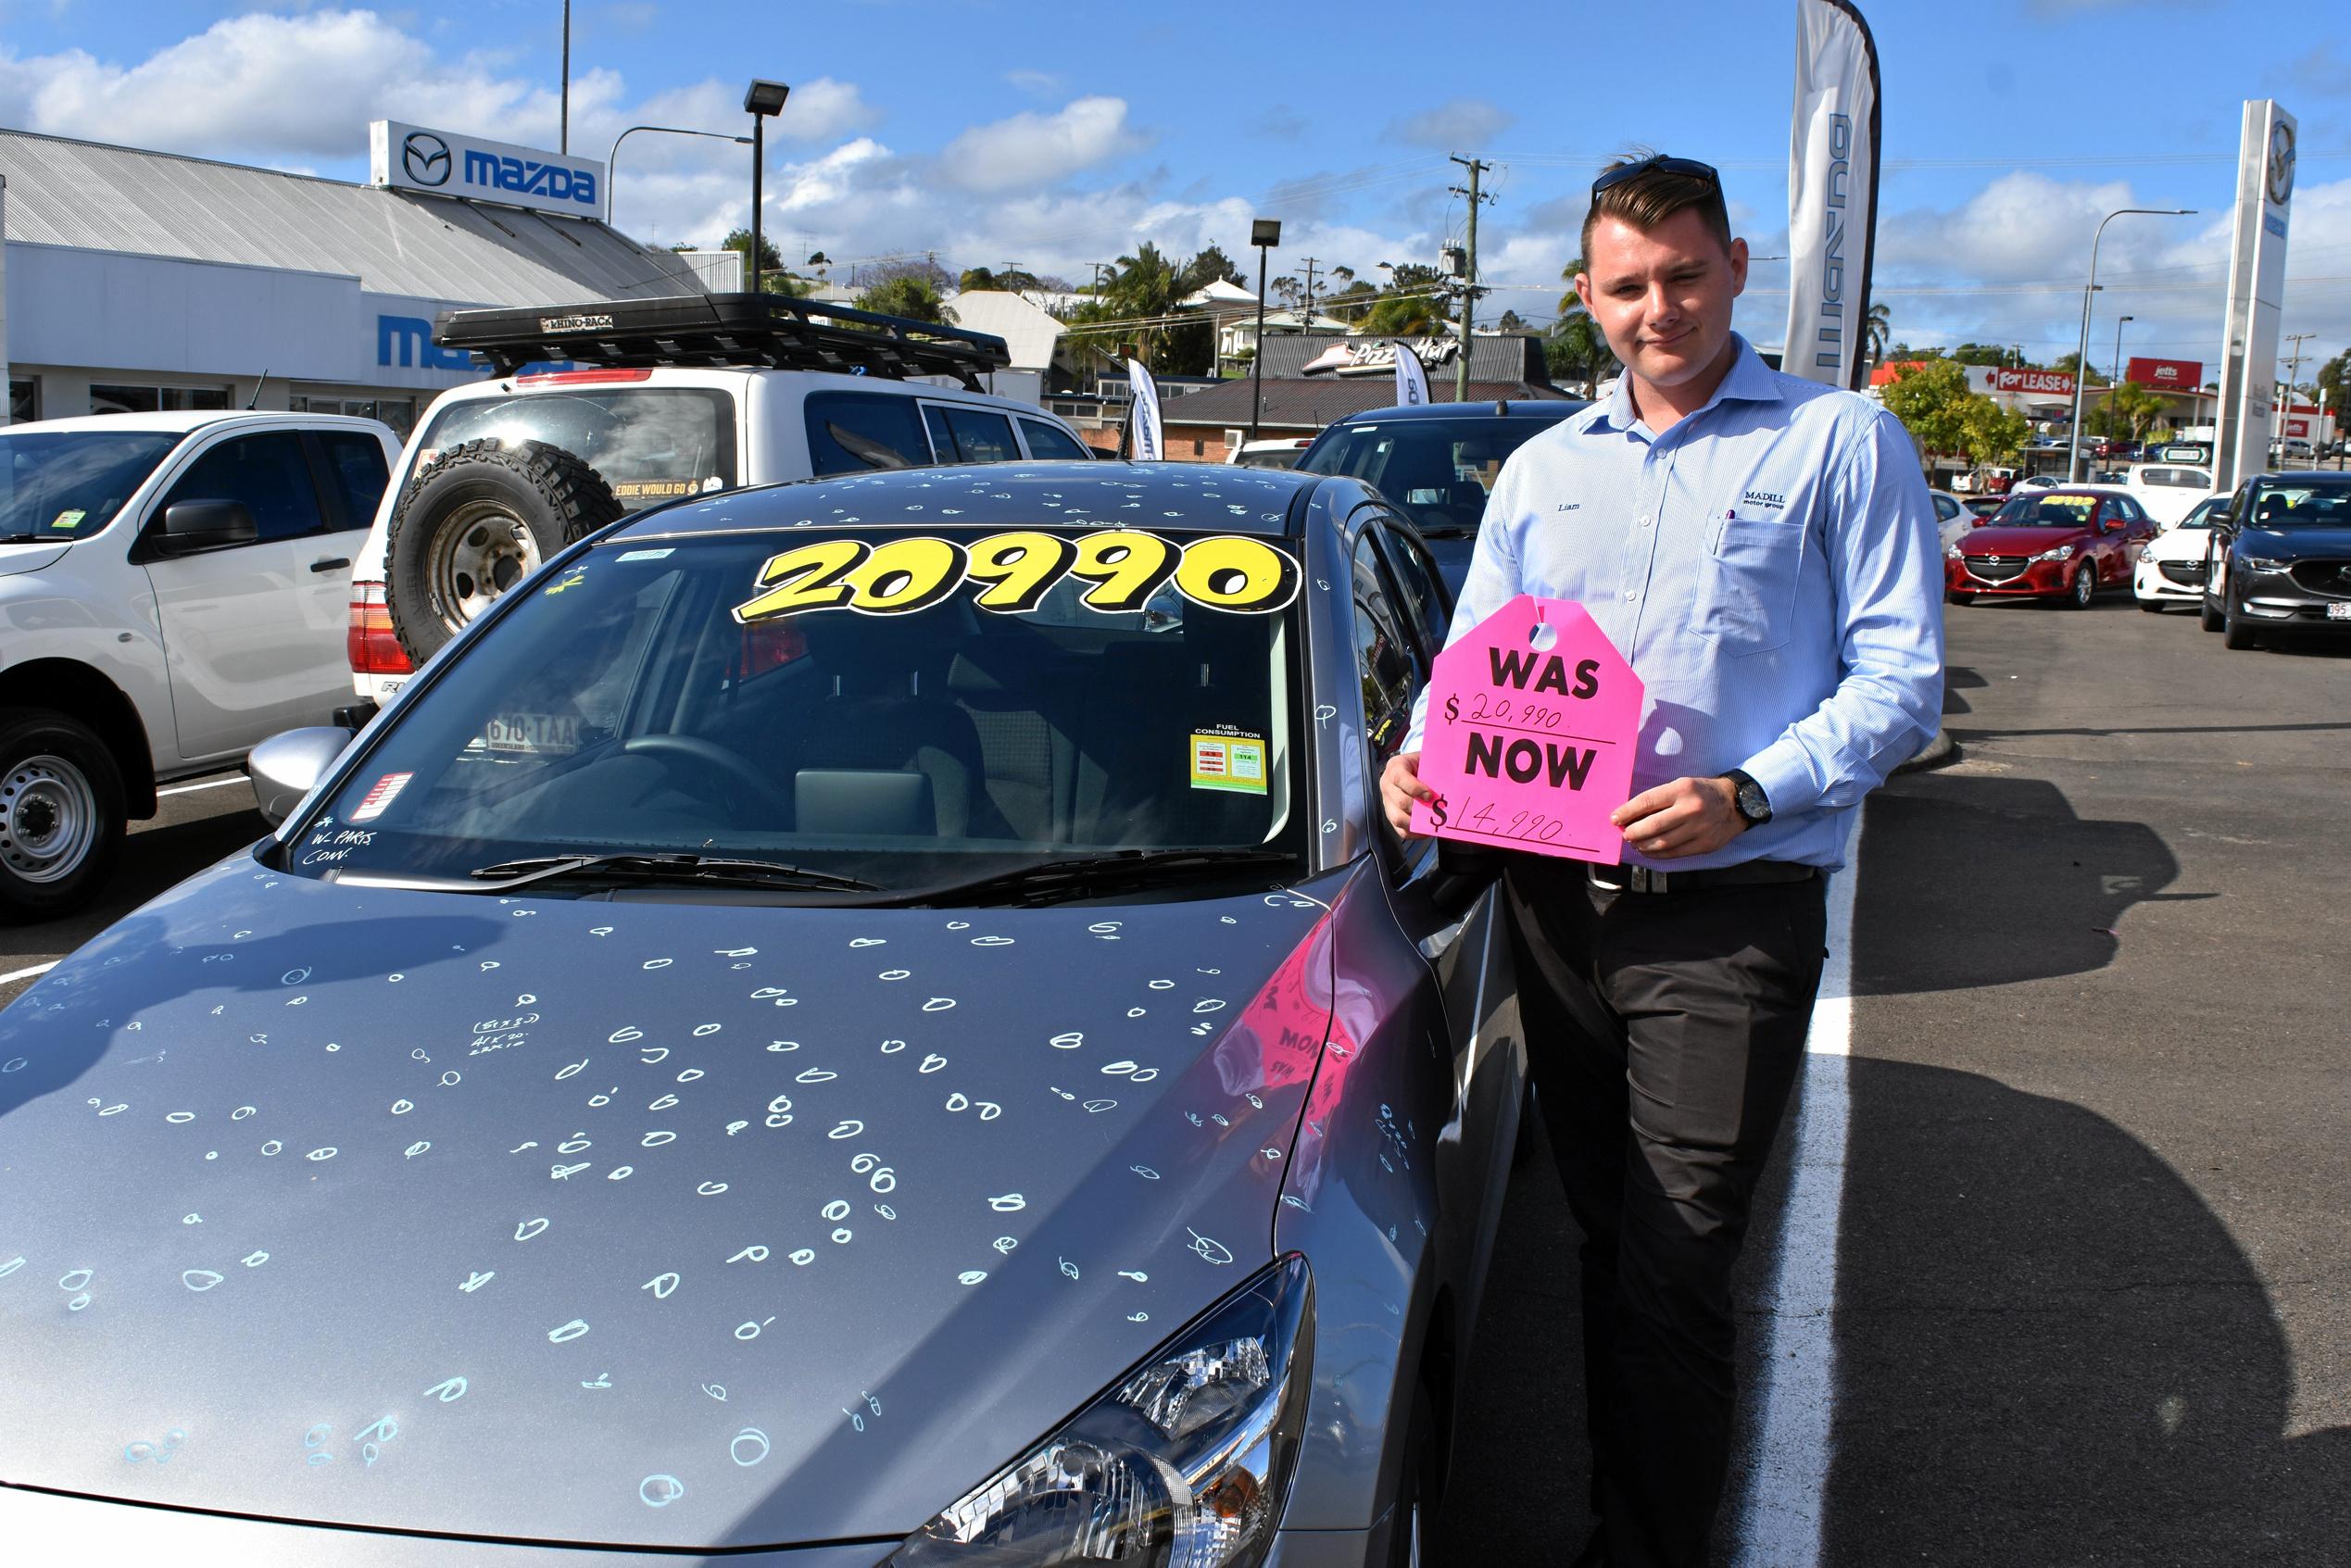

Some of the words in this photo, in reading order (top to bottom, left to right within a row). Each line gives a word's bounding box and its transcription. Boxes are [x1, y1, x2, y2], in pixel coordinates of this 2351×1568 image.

[550, 316, 612, 329] RHINO-RACK
[1350, 341, 1396, 366] Pizz
[1412, 336, 1459, 360] Hut
[2022, 373, 2062, 391] LEASE
[615, 484, 640, 496] EDDIE
[641, 483, 673, 495] WOULD
[673, 483, 686, 495] GO
[1745, 492, 1786, 504] MADILL
[731, 529, 1301, 623] 20990
[1489, 646, 1601, 699] WAS
[1195, 728, 1261, 738] CONSUMPTION
[1465, 732, 1597, 791] NOW
